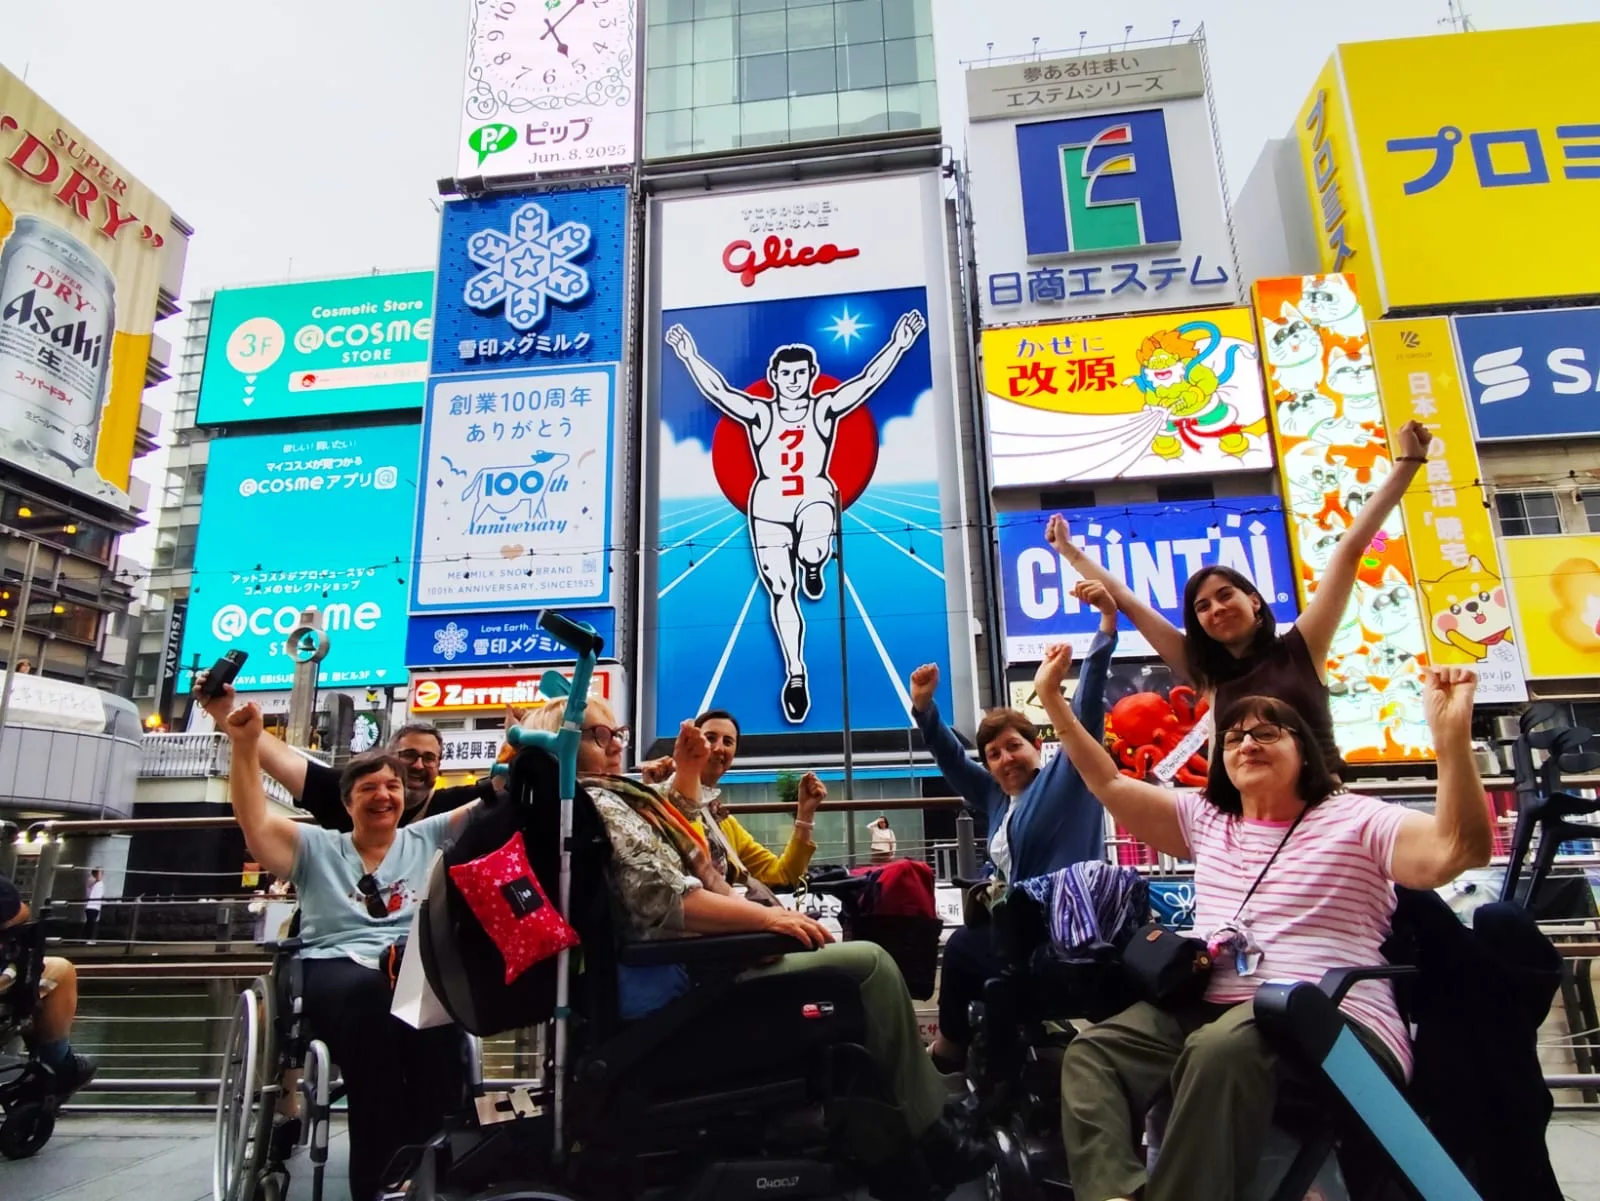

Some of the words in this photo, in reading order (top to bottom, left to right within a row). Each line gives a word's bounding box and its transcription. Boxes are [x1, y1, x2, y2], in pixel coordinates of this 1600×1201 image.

[494, 1, 516, 21] 10
[598, 17, 617, 29] 3
[487, 30, 505, 42] 9
[592, 41, 609, 55] 4
[493, 51, 512, 66] 8
[571, 58, 587, 75] 5
[1023, 56, 1140, 82] 夢ある住まい
[515, 66, 533, 80] 7
[542, 69, 557, 85] 6
[1006, 76, 1164, 108] エステムシリーズ
[525, 117, 593, 146] ピップ
[51, 126, 129, 198] SUPER
[1306, 89, 1356, 272] プロミス
[988, 255, 1229, 306] 日商エステム
[311, 302, 379, 319] Cosmetic
[383, 299, 424, 313] Store
[3, 288, 103, 369] Asahi
[293, 318, 433, 355] @cosme
[238, 332, 273, 358] 3F
[341, 348, 392, 363] STORE
[457, 332, 591, 360] 雪印メグミルク
[1015, 334, 1106, 358] かぜに
[37, 346, 63, 373] 生
[15, 369, 74, 406] スーパードライ
[1006, 355, 1120, 398] 改源
[448, 385, 594, 416] 創業100周年
[465, 416, 574, 443] ありがとう
[778, 424, 807, 497] グリコ
[462, 518, 568, 536] Anniversary
[447, 570, 495, 580] MEMILK
[535, 565, 573, 577] BRAND
[211, 601, 382, 642] @come
[480, 624, 502, 633] Love
[164, 611, 183, 679] TSUTAYA
